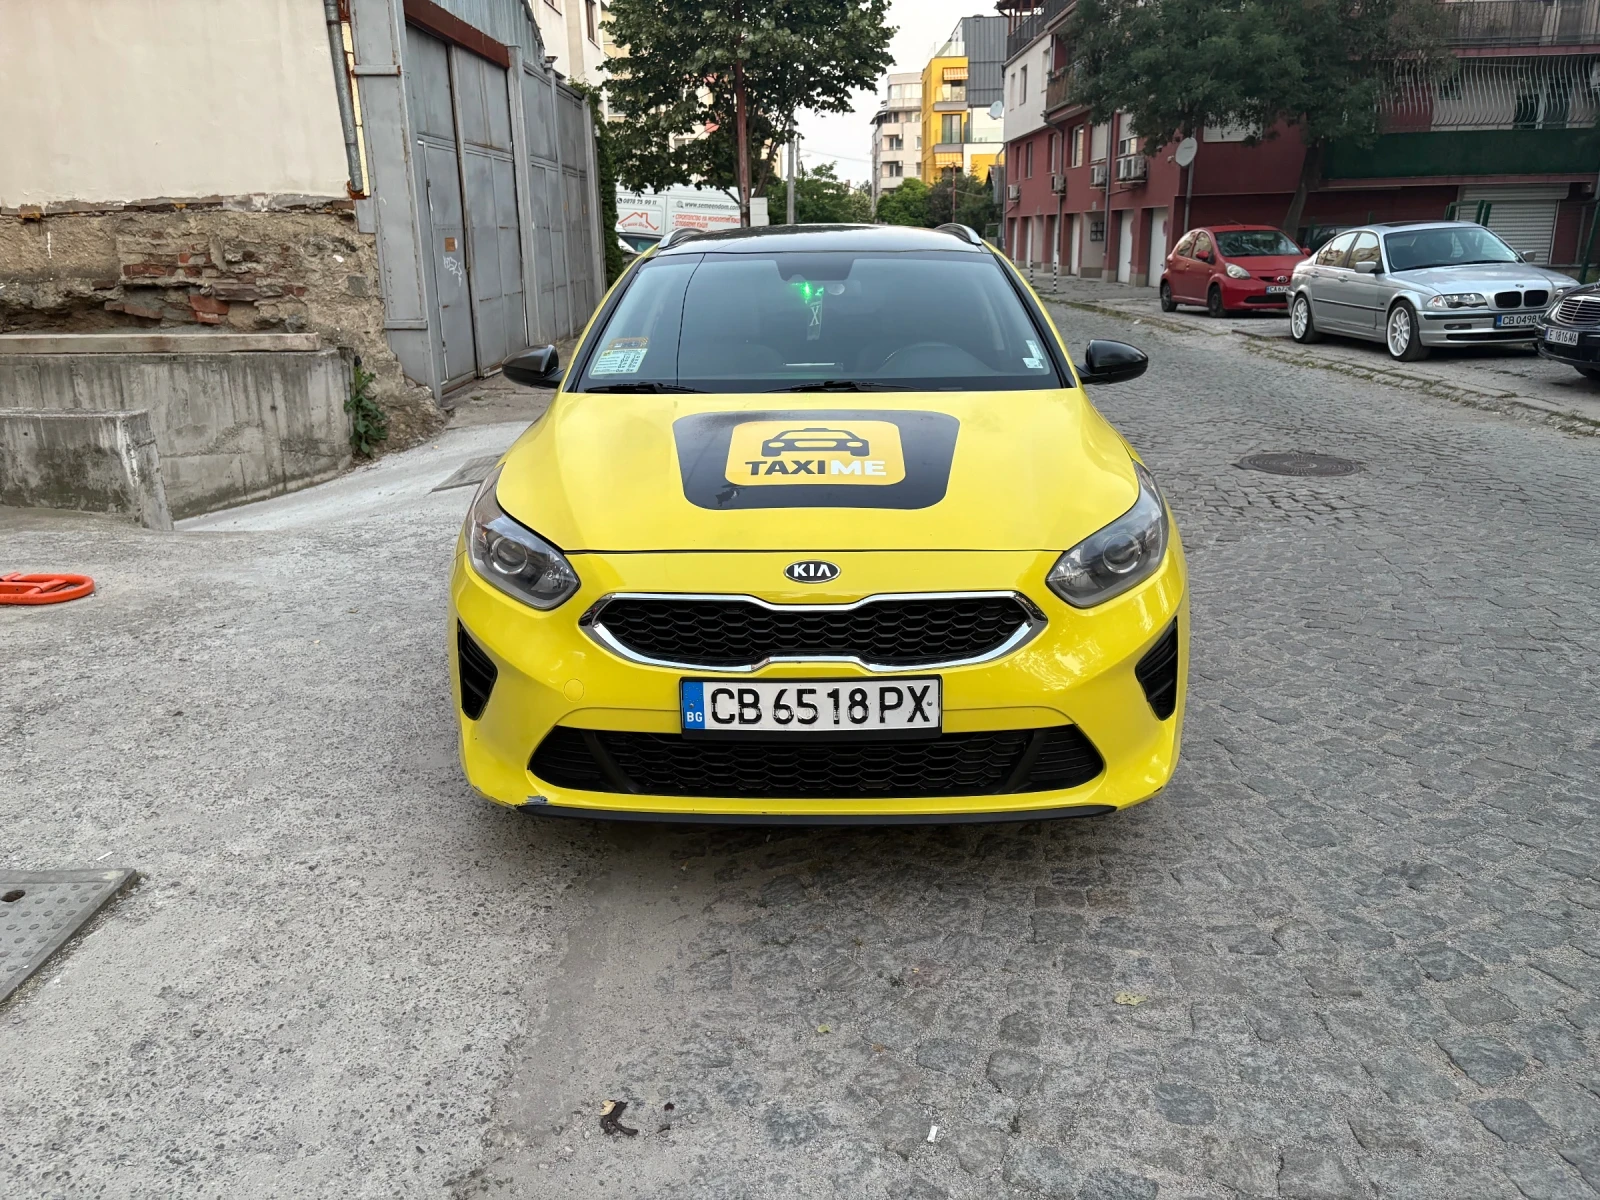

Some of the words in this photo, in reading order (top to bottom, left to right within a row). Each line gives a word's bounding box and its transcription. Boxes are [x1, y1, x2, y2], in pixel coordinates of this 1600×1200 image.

[1516, 315, 1537, 324] 0498
[793, 563, 832, 577] KIA
[710, 687, 763, 725] CB
[772, 687, 870, 725] 6518
[879, 685, 931, 724] PX
[686, 711, 703, 723] BG
